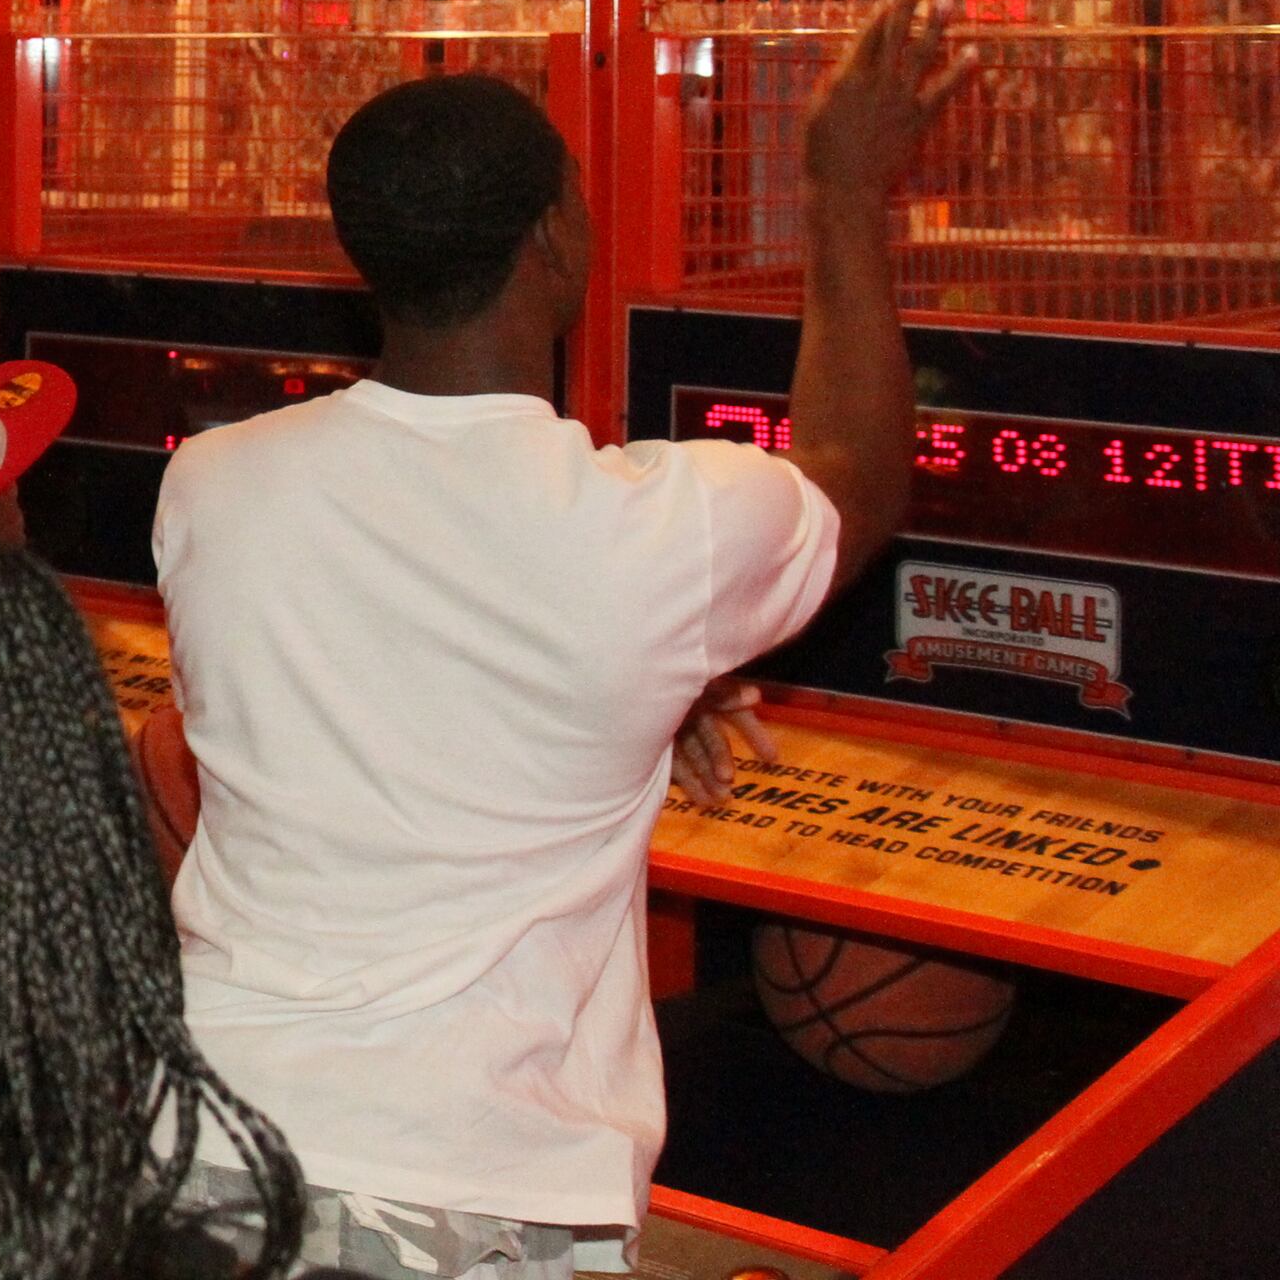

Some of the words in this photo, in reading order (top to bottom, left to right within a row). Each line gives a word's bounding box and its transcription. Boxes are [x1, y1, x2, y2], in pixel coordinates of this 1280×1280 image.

[992, 429, 1067, 477] 08
[1103, 439, 1182, 488] 12
[910, 574, 998, 626] SKEE
[1010, 586, 1107, 644] BALL
[964, 625, 1045, 647] INCORPORATED
[914, 639, 1028, 668] AMUSEMENT
[1033, 652, 1097, 681] GAMES
[730, 782, 850, 815] AMES
[848, 805, 953, 834] ARE
[949, 822, 1128, 867] LINKED
[856, 779, 934, 803] WITH
[942, 793, 1024, 818] YOUR
[1029, 809, 1166, 844] FRIENDS
[662, 797, 693, 814] OR
[699, 805, 778, 829] HEAD
[784, 819, 823, 838] TO
[826, 829, 909, 855] HEAD
[914, 845, 1129, 896] COMPETITION
